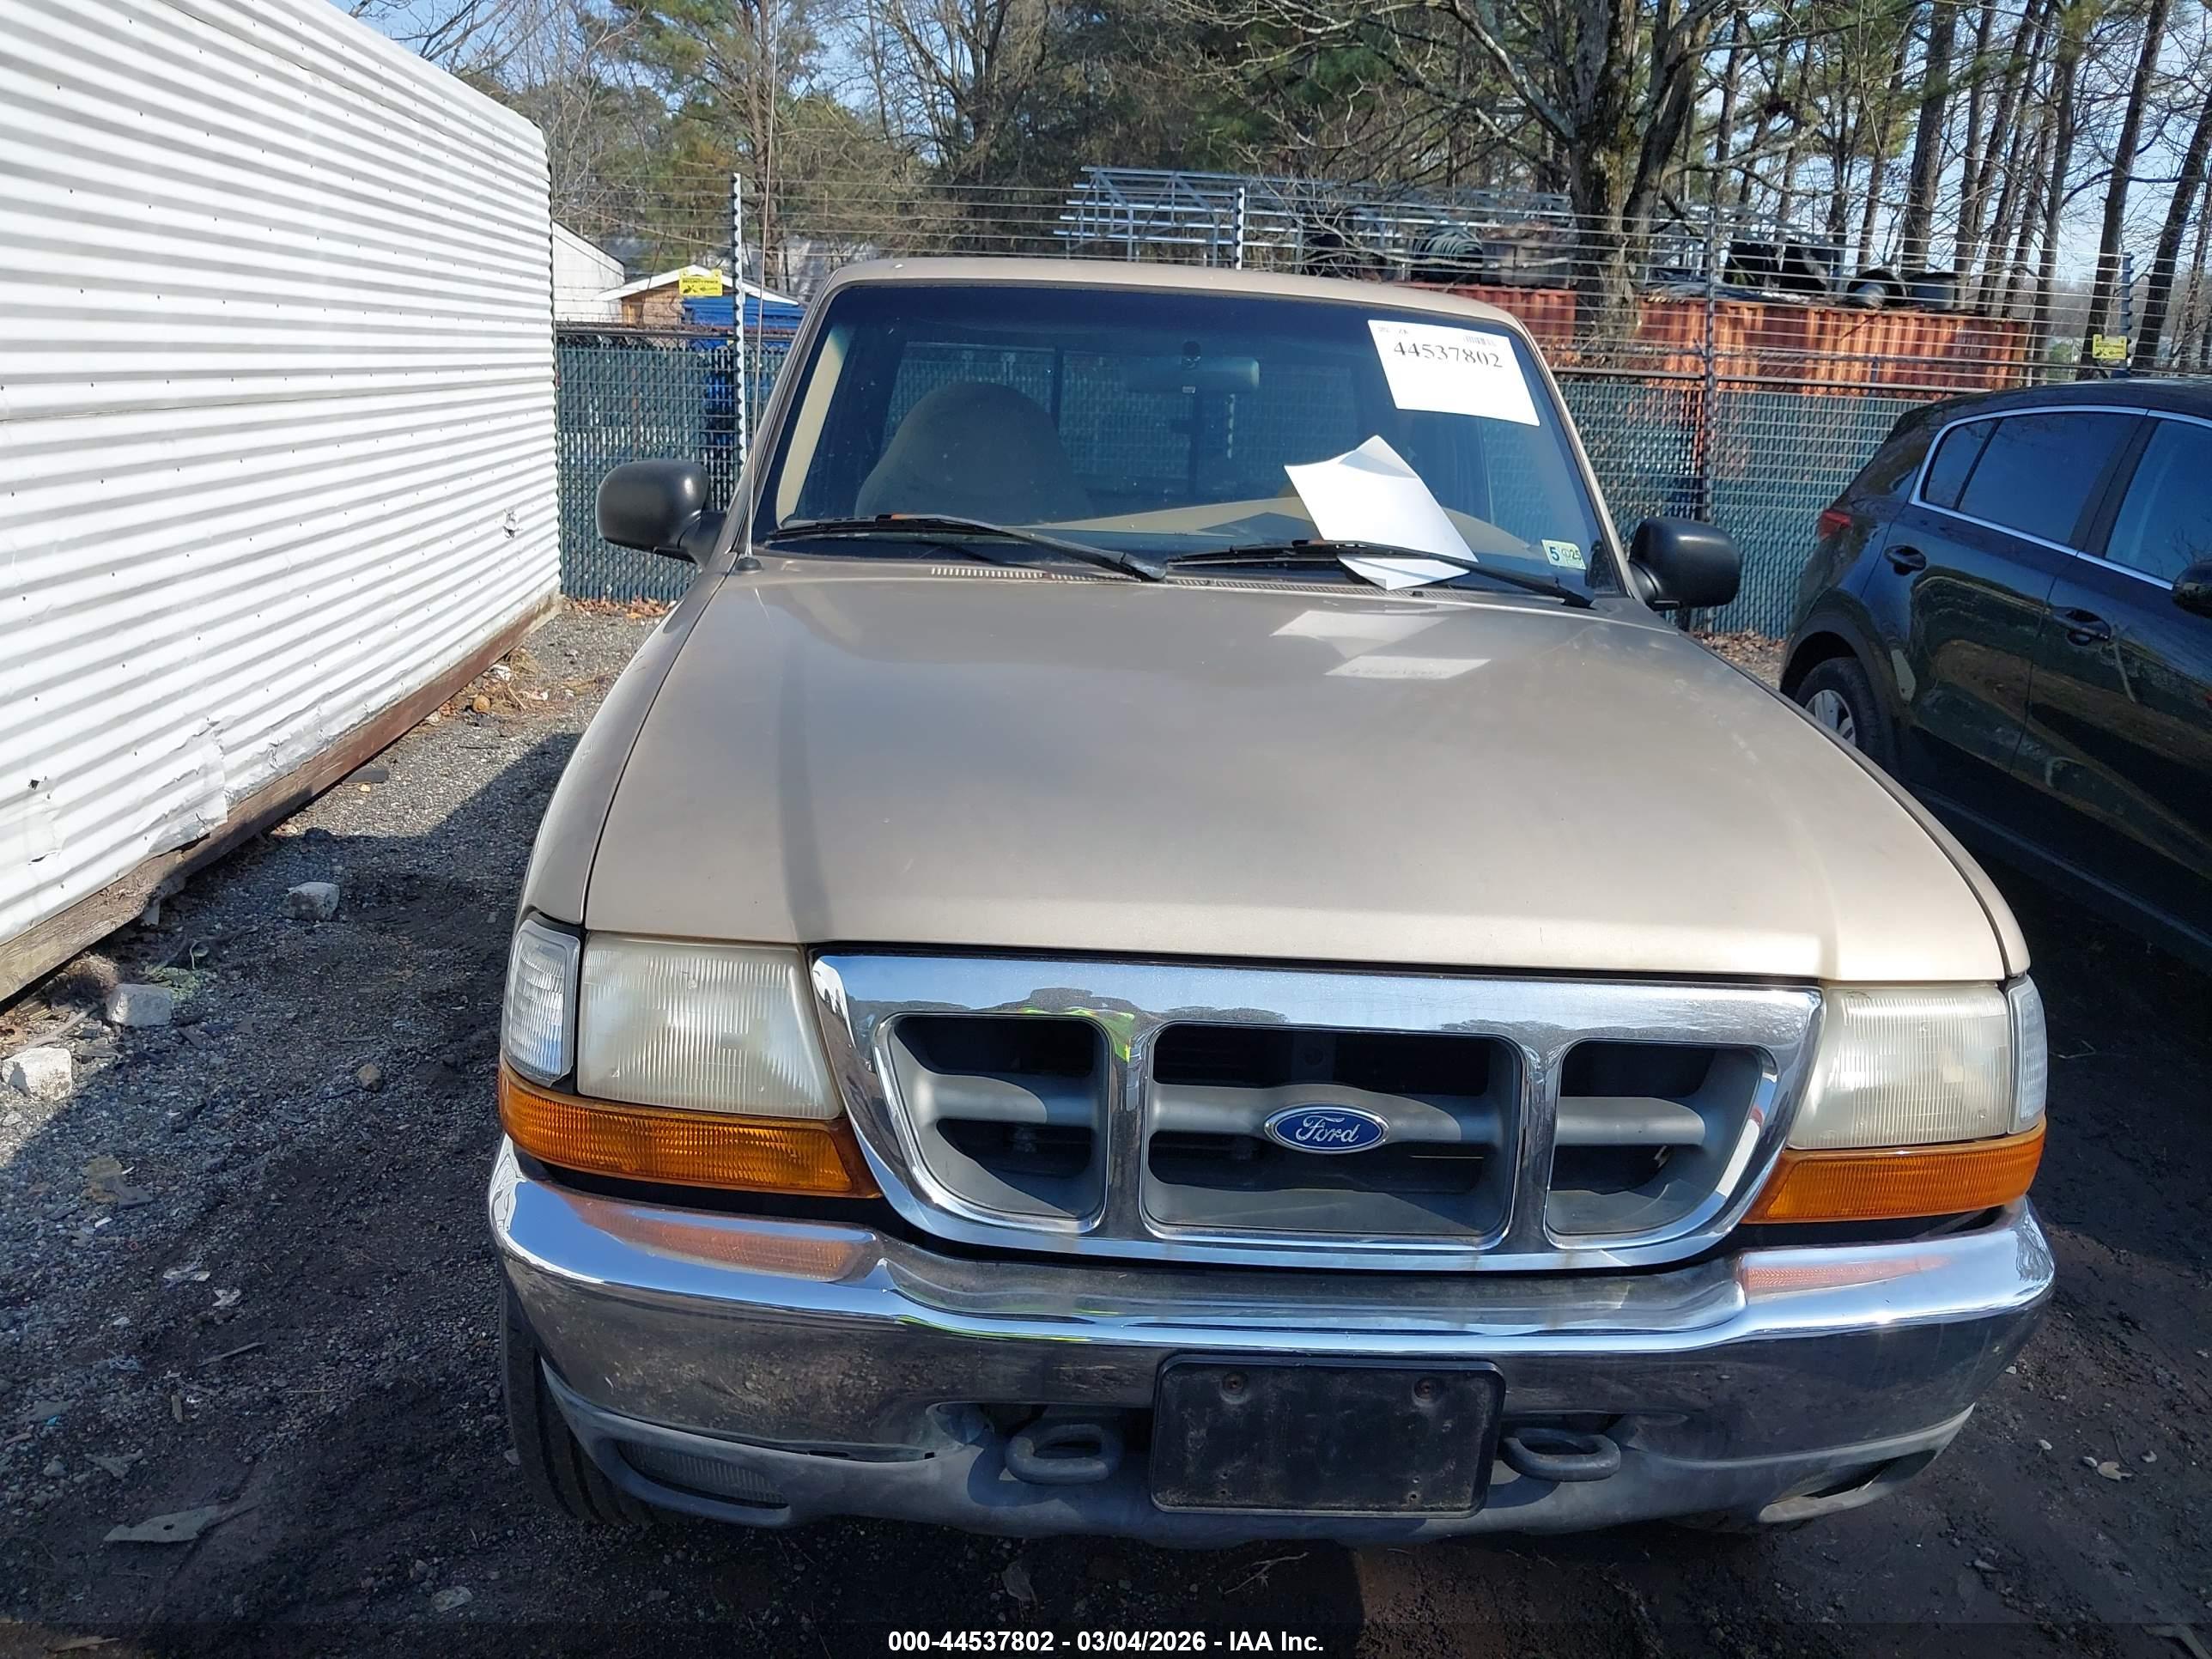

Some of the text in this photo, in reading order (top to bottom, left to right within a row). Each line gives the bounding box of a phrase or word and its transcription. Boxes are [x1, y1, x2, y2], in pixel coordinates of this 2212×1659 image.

[1394, 342, 1503, 368] 44537802
[1549, 546, 1560, 561] 5
[1296, 1115, 1360, 1143] Ford
